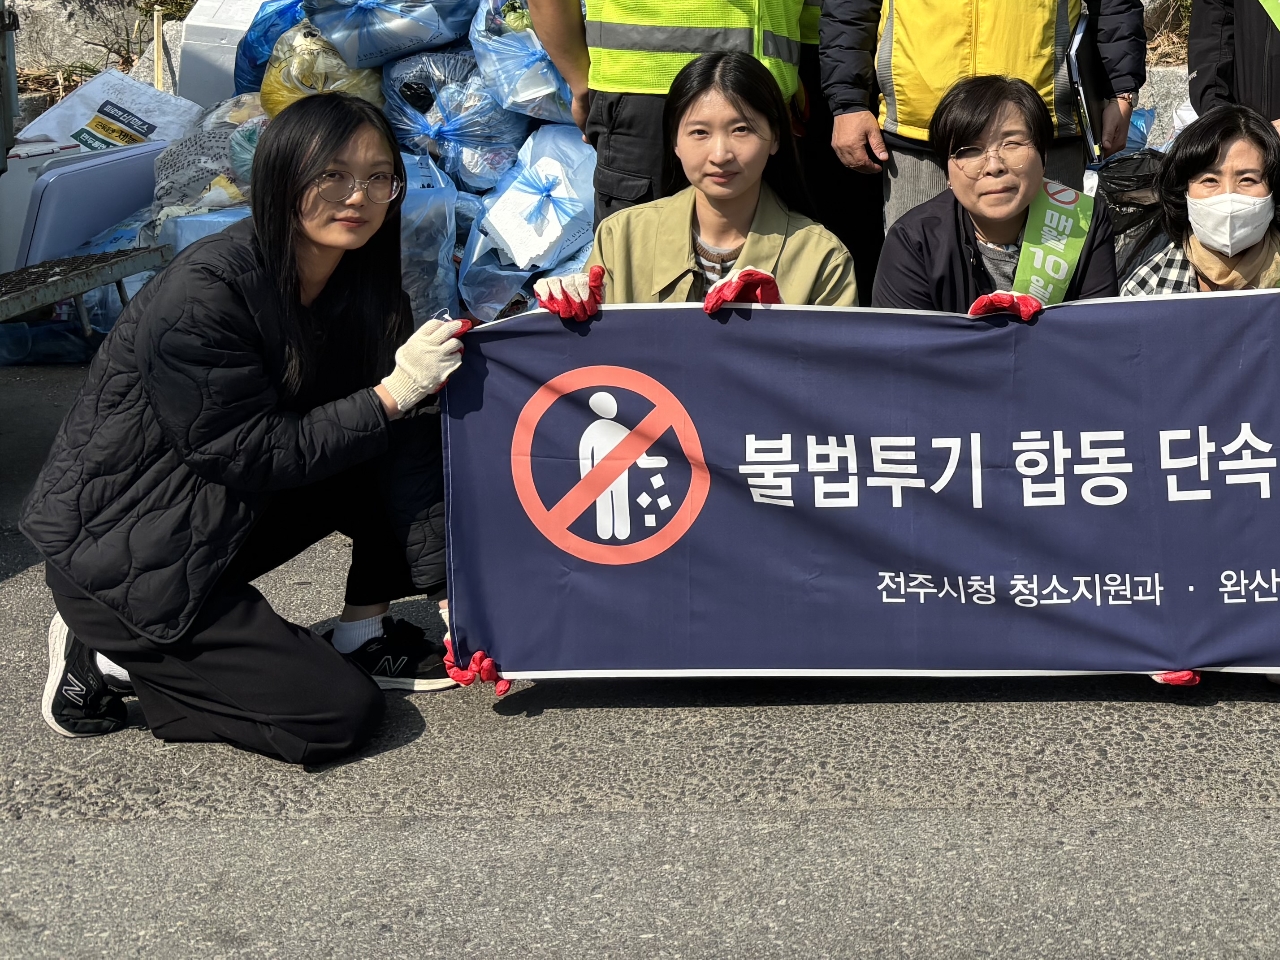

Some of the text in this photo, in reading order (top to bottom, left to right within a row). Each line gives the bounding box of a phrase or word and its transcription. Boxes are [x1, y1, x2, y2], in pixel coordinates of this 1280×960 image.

[1029, 210, 1073, 306] 매월 10일
[739, 433, 982, 509] 불법투기
[1013, 430, 1133, 507] 합동
[877, 571, 996, 605] 전주시청
[1009, 572, 1164, 608] 청소지원과
